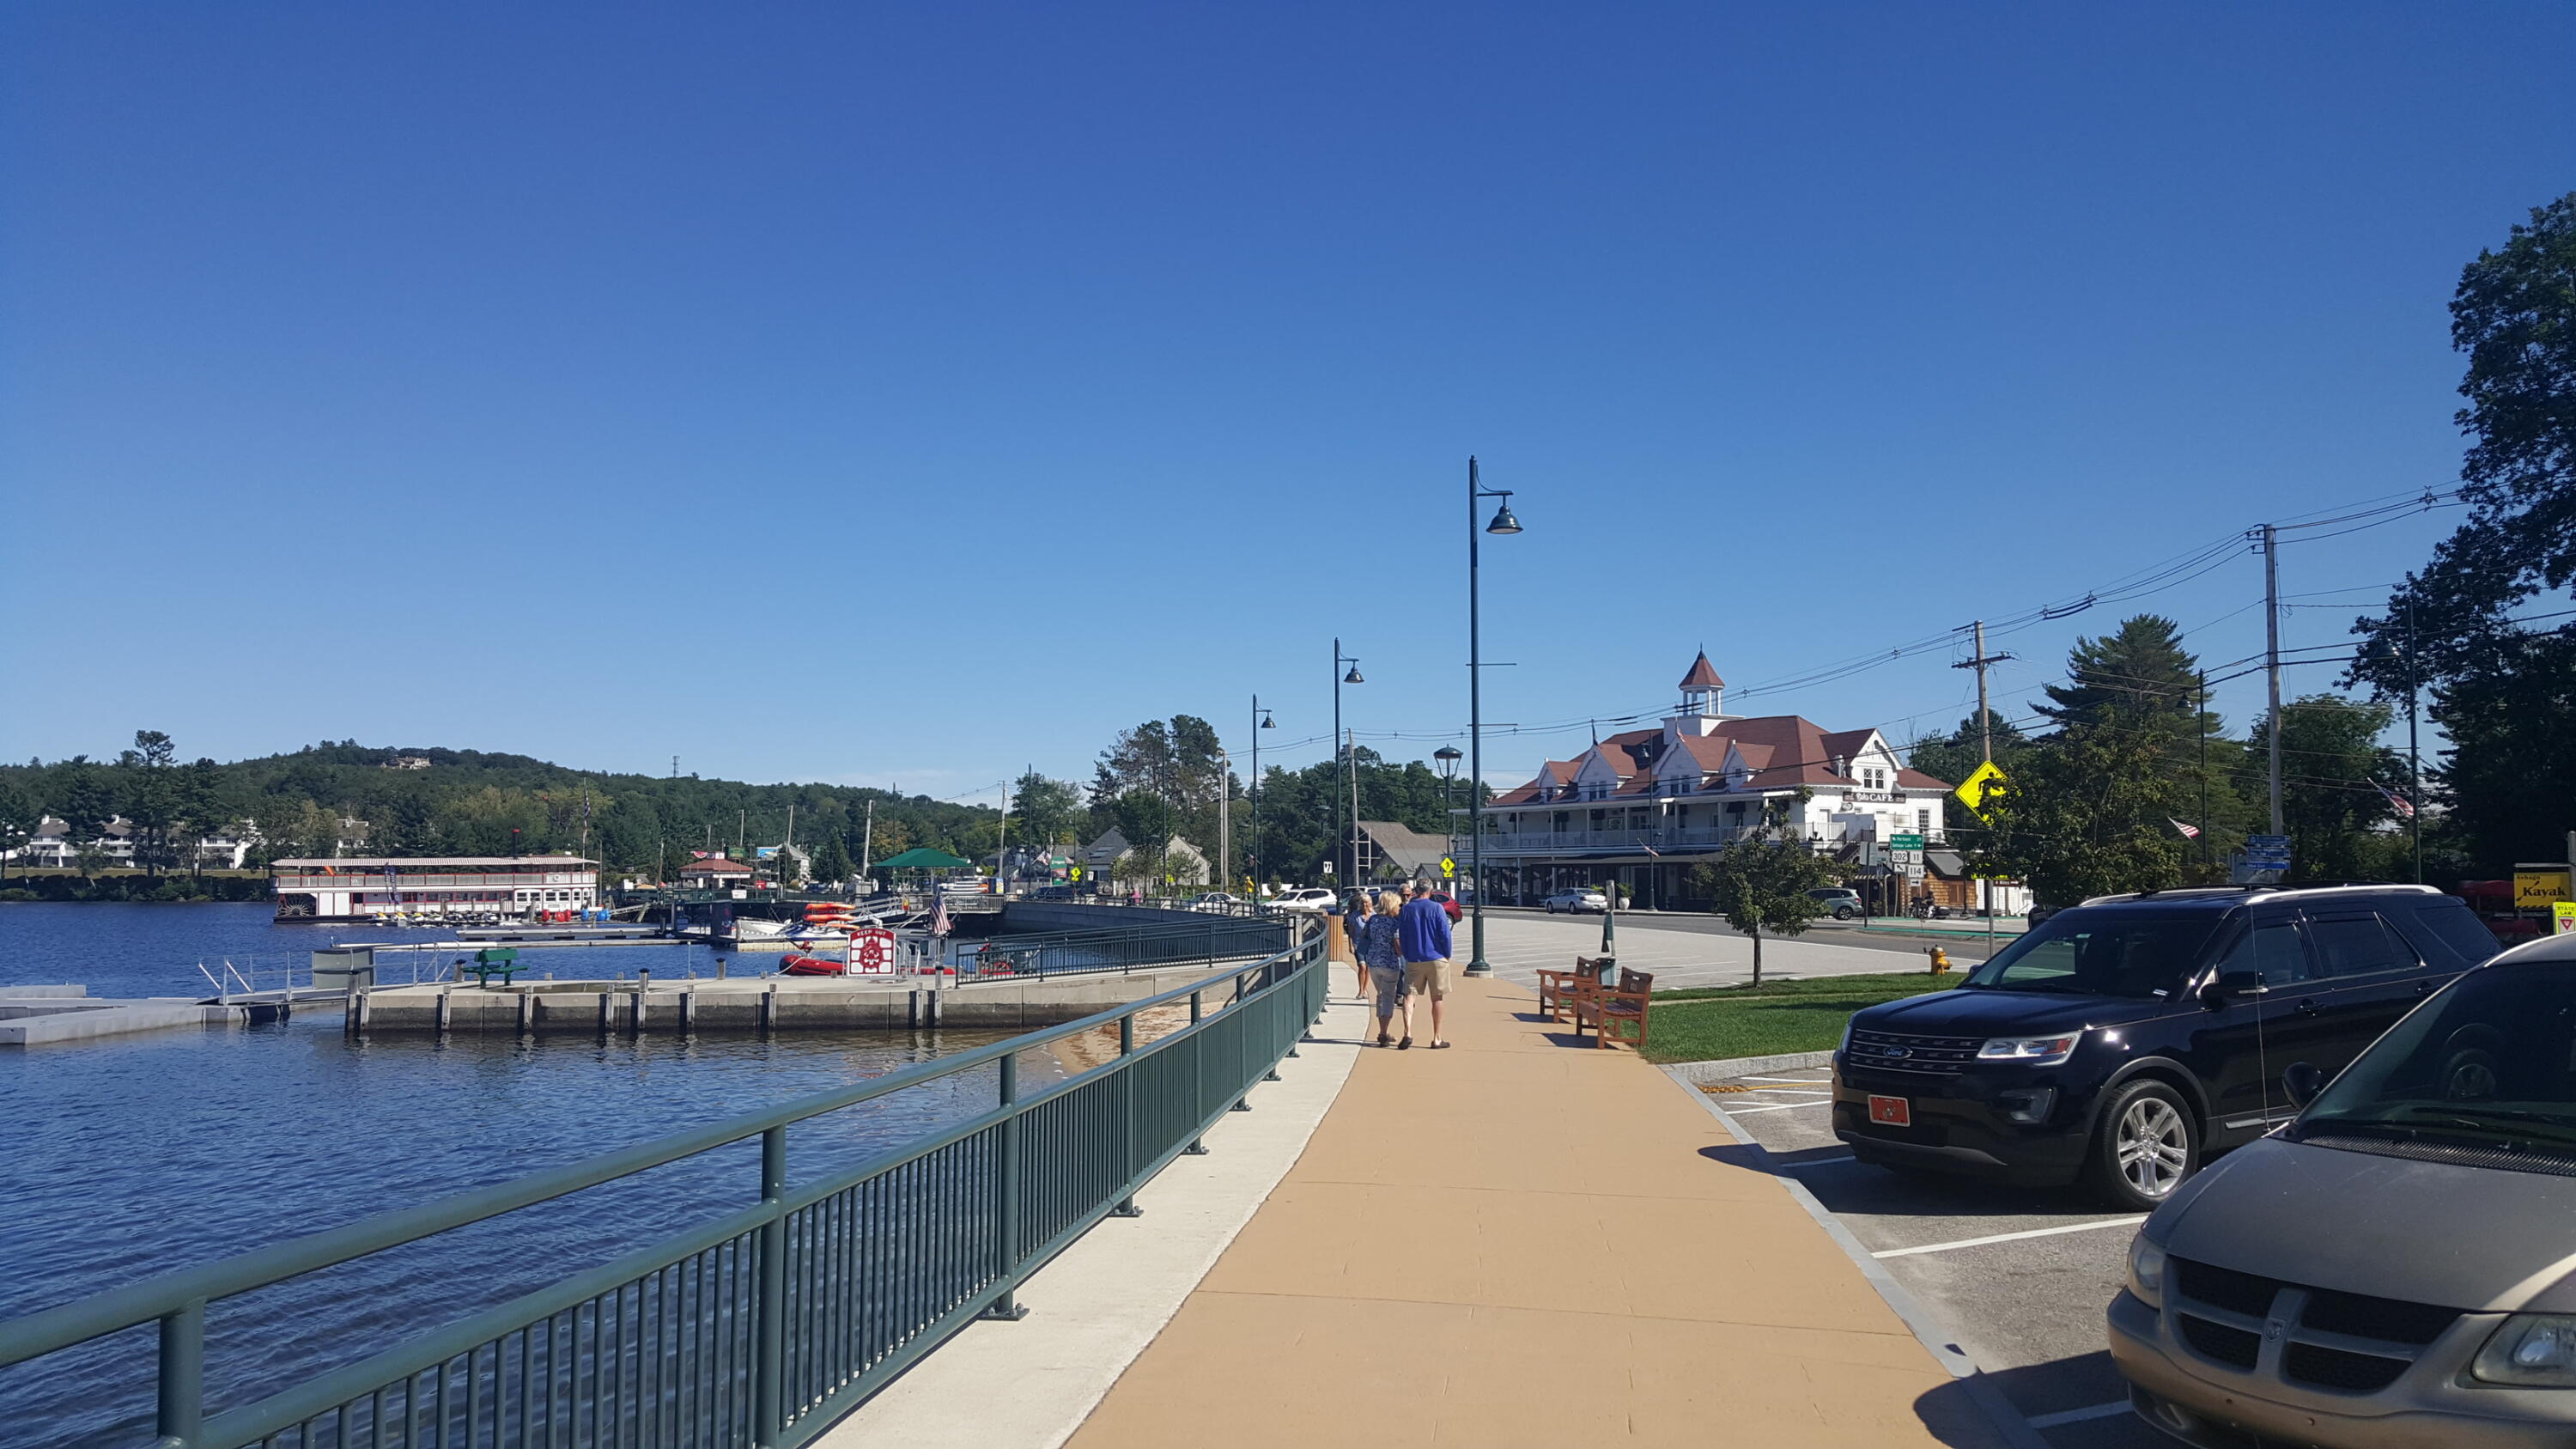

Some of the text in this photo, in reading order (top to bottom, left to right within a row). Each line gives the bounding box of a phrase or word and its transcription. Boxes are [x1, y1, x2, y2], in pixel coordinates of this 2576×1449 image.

[1893, 852, 1907, 861] 302
[1912, 853, 1920, 861] 11
[1910, 867, 1922, 875] 114
[2523, 886, 2566, 898] Kayak
